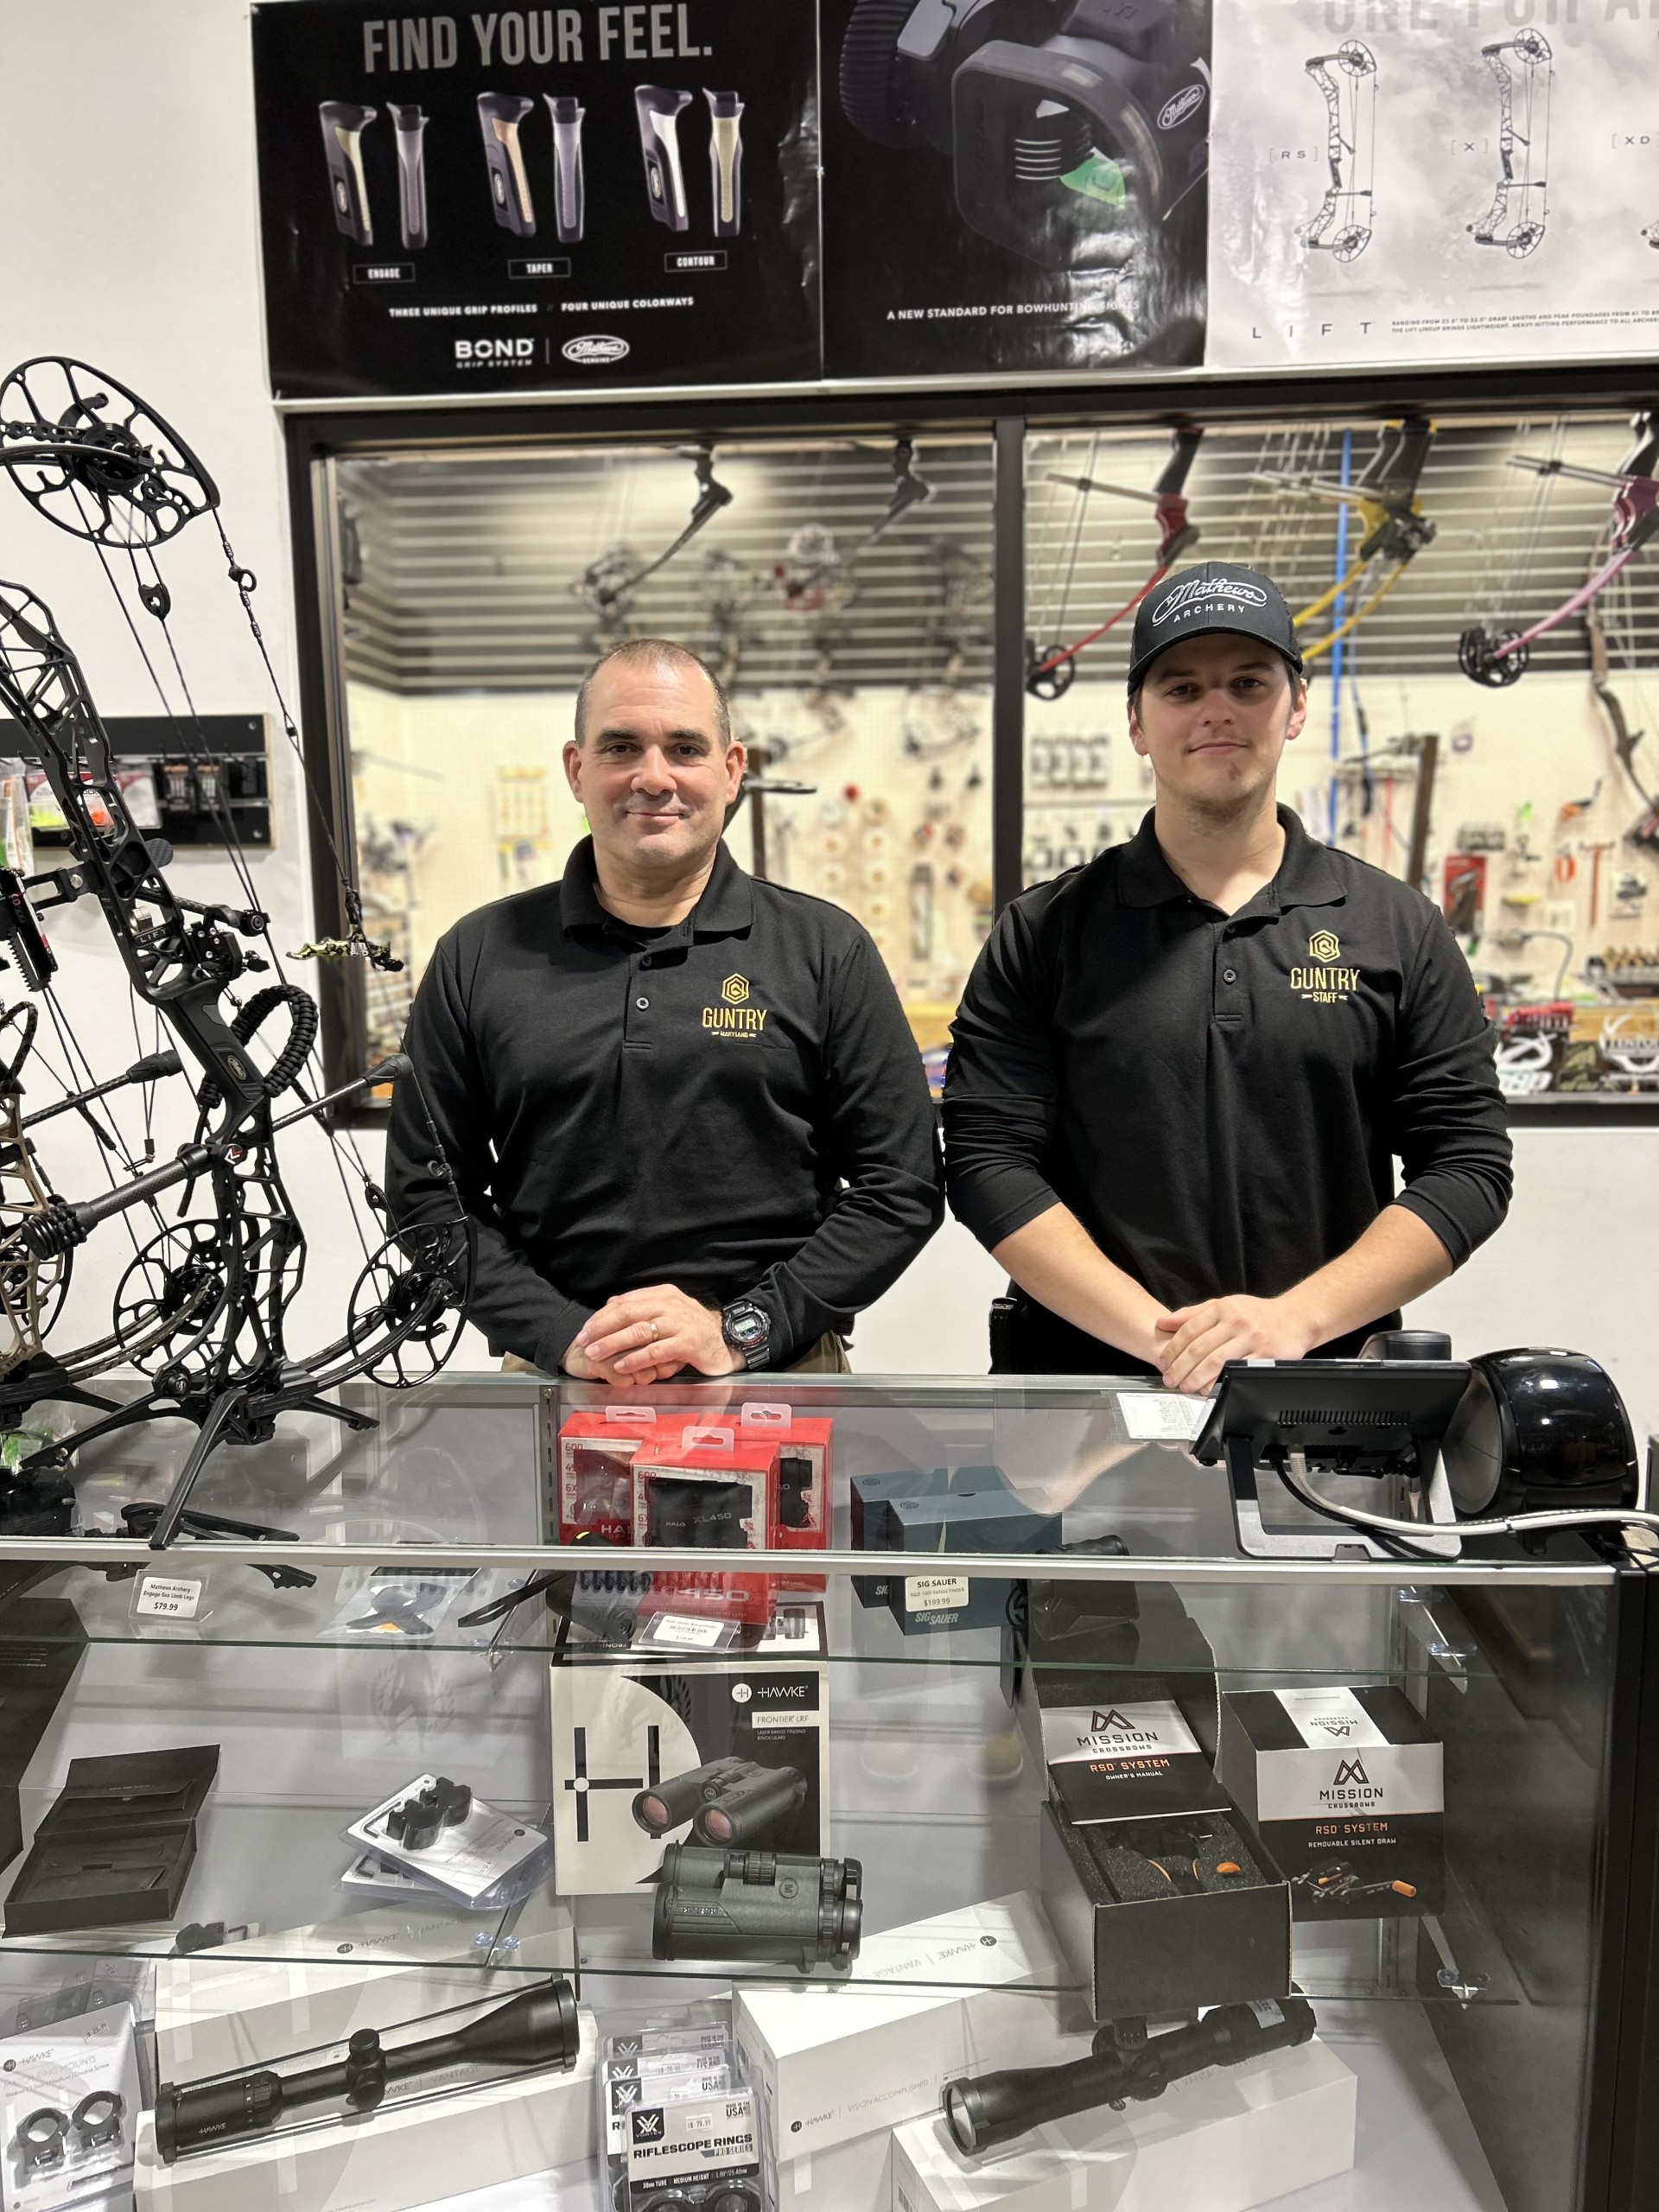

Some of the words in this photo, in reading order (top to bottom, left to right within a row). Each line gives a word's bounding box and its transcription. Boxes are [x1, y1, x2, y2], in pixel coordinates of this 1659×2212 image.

[363, 16, 458, 73] FIND
[472, 9, 583, 67] YOUR
[599, 3, 713, 61] FEEL.
[677, 256, 715, 267] CONTOUR
[367, 267, 401, 279] ENGAGE
[526, 263, 553, 274] TAPER
[389, 308, 421, 318] THREE
[423, 306, 462, 317] UNIQUE
[464, 305, 488, 316] GRIP
[491, 303, 537, 315] PROFILES
[561, 301, 589, 312] FOUR
[591, 299, 630, 310] UNIQUE
[632, 296, 694, 308] COLORWAYS
[887, 310, 895, 320] A
[898, 309, 924, 320] NEW
[927, 306, 987, 318] STANDARD
[990, 304, 1014, 315] FOR
[1016, 302, 1095, 314] BOWHUNTING
[454, 338, 533, 359] BOND
[455, 360, 484, 369] GRIP
[487, 359, 532, 367] SYSTEM
[1160, 577, 1264, 610] Mathews
[1173, 603, 1246, 623] ARCHERY
[139, 928, 167, 944] LIFT
[1290, 967, 1361, 991] GUNTRY
[1313, 992, 1338, 1003] STAFF
[702, 1007, 768, 1031] GUNTRY
[565, 1443, 583, 1452] 600
[638, 1471, 657, 1480] 600
[692, 1512, 732, 1524] XL450
[931, 1578, 957, 1587] SAUER
[154, 1601, 178, 1611] $79.99
[923, 1598, 950, 1607] $199.99
[757, 1686, 805, 1698] HAWKE
[796, 1714, 809, 1723] LRF
[1077, 1732, 1159, 1746] MISSION
[1092, 1745, 1152, 1753] CROSSBOWS
[1090, 1764, 1115, 1772] RSD
[1121, 1759, 1170, 1770] SYSTEM
[1319, 1788, 1383, 1800] MISSION
[1315, 1825, 1338, 1834] RSD
[1344, 1822, 1388, 1834] SYSTEM
[359, 1932, 400, 1948] HAWKE
[60, 2055, 97, 2072] MOUNTS
[702, 2081, 719, 2091] USA
[805, 2111, 832, 2126] HAWKE
[848, 2099, 873, 2113] VISION
[874, 2078, 930, 2103] ACCOMPLISHED
[726, 2107, 745, 2118] USA
[199, 2122, 226, 2135] HAWKE
[633, 2139, 712, 2159] RIFLESCOPE
[714, 2133, 753, 2148] RINGS
[715, 2148, 727, 2158] PRO
[729, 2144, 752, 2156] SERIES
[655, 2180, 667, 2189] TUBE
[673, 2176, 692, 2185] MEDIUM
[692, 2173, 709, 2182] HEIGHT
